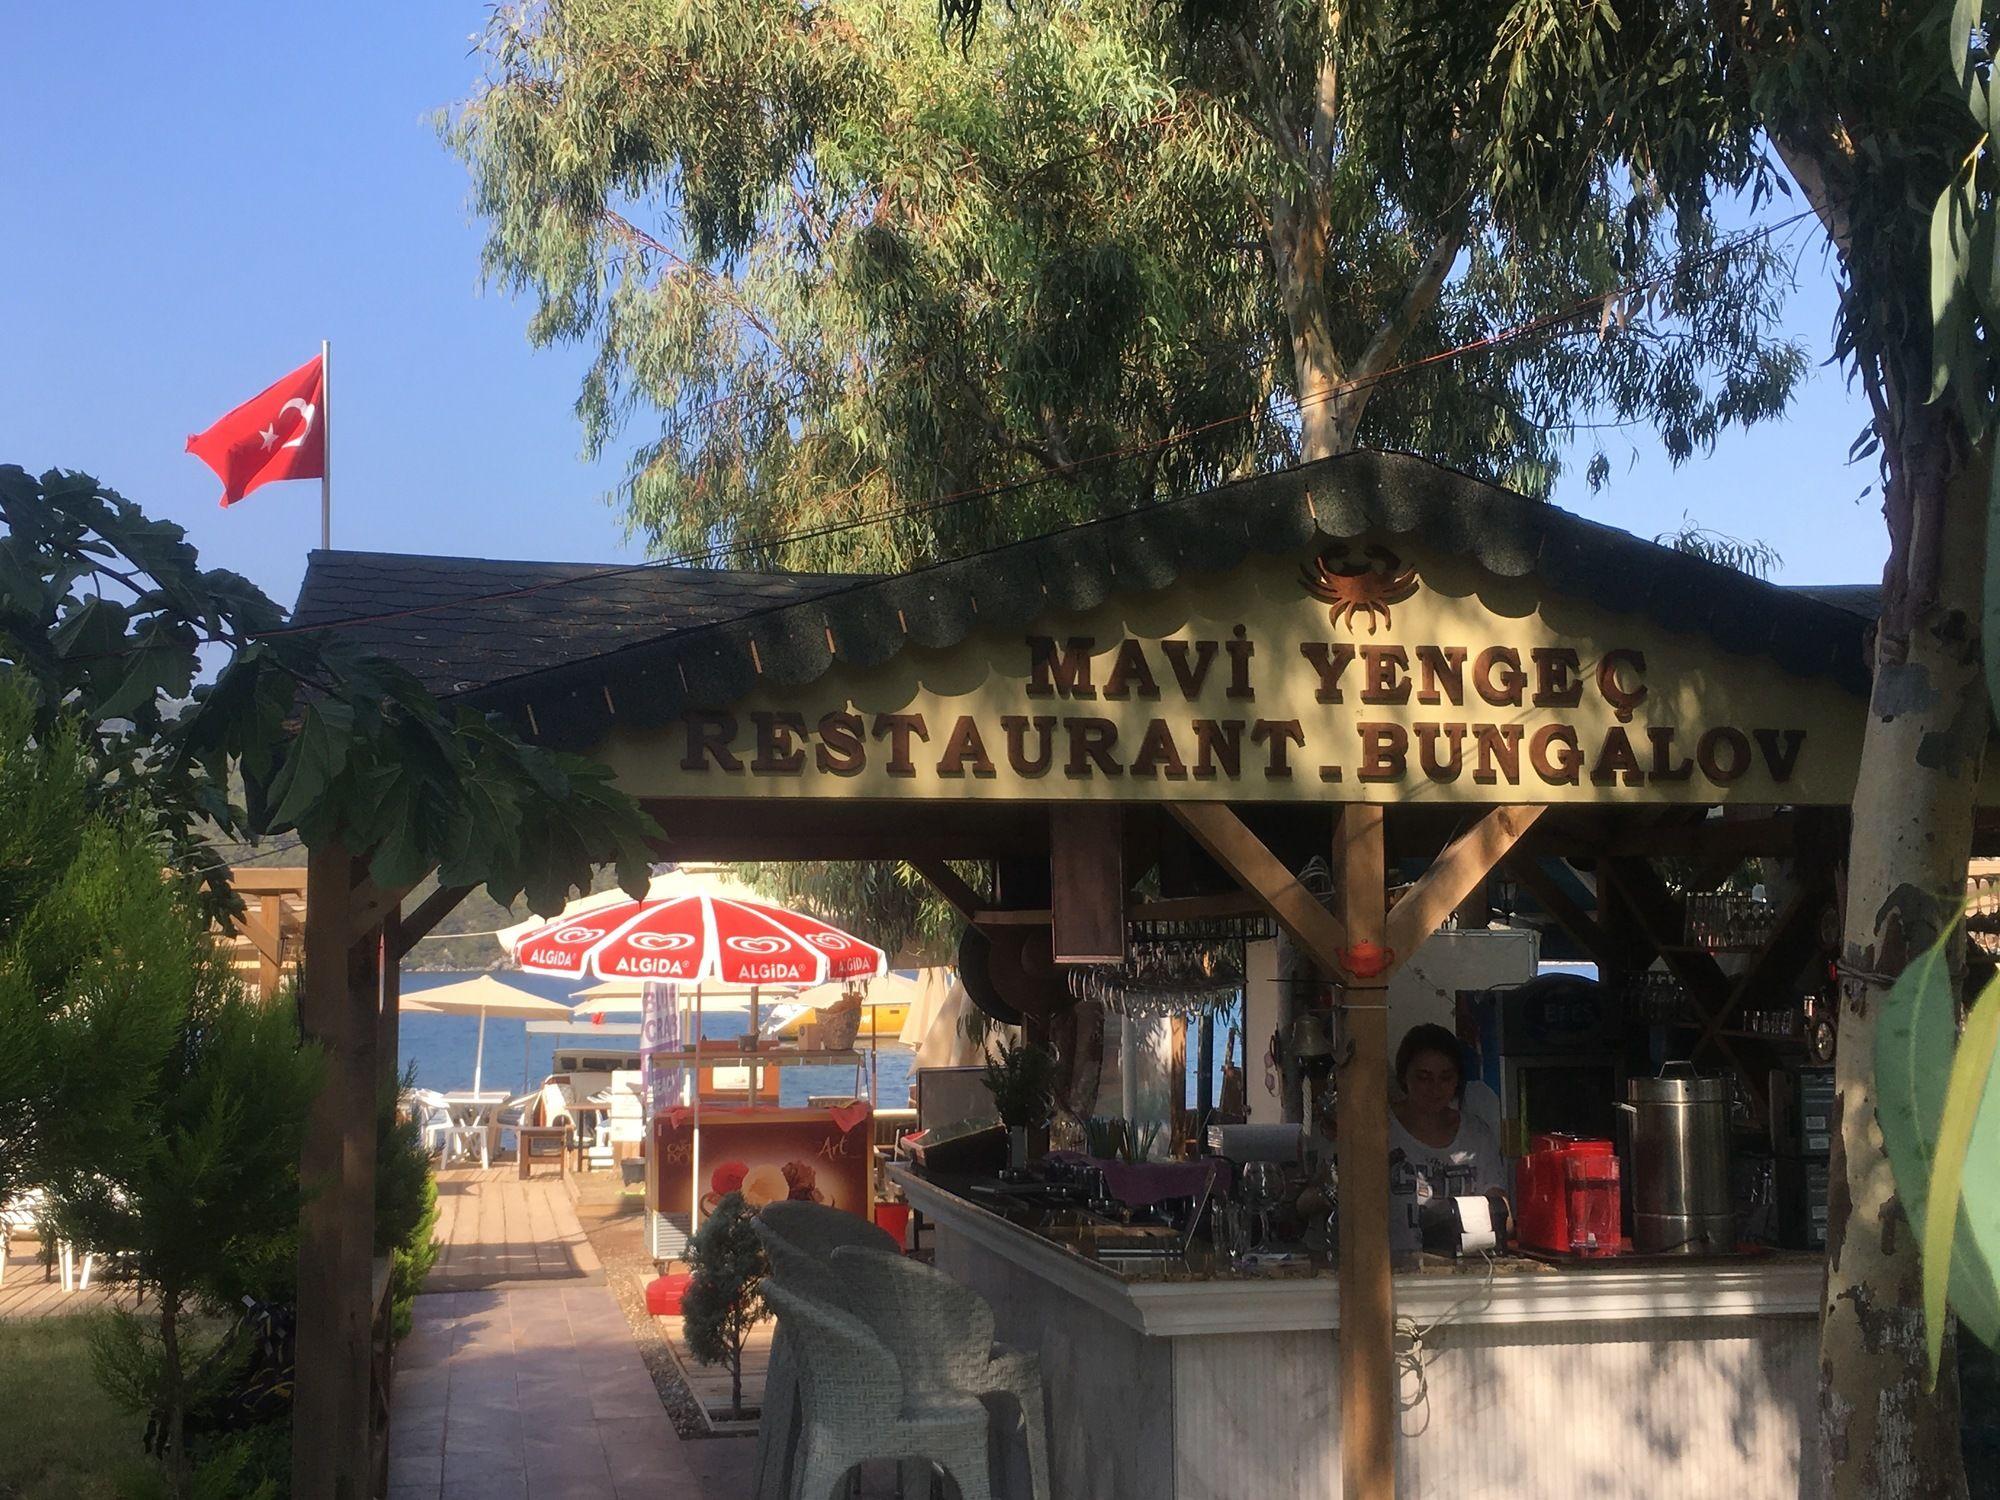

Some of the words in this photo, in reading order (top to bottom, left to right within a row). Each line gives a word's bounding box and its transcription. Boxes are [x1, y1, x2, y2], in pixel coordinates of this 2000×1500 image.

[1026, 624, 1255, 701] MAVİ
[1300, 642, 1648, 724] YENGEÇ
[1356, 722, 1808, 789] BUNGALOV
